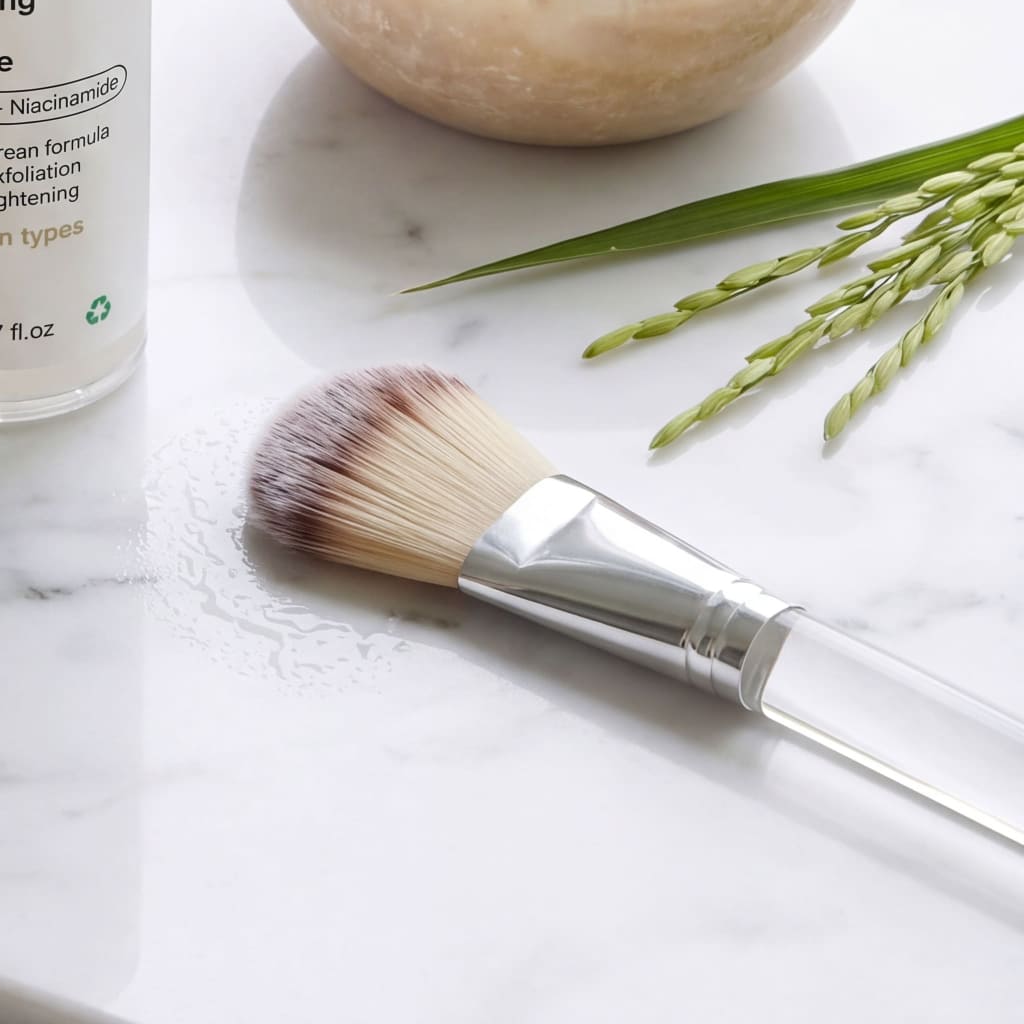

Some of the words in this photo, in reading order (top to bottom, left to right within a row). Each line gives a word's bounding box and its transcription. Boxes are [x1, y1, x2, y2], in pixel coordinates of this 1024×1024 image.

[10, 76, 119, 116] Niacinamide
[44, 124, 110, 157] formula
[20, 219, 85, 249] types
[9, 322, 56, 342] fl.oz
